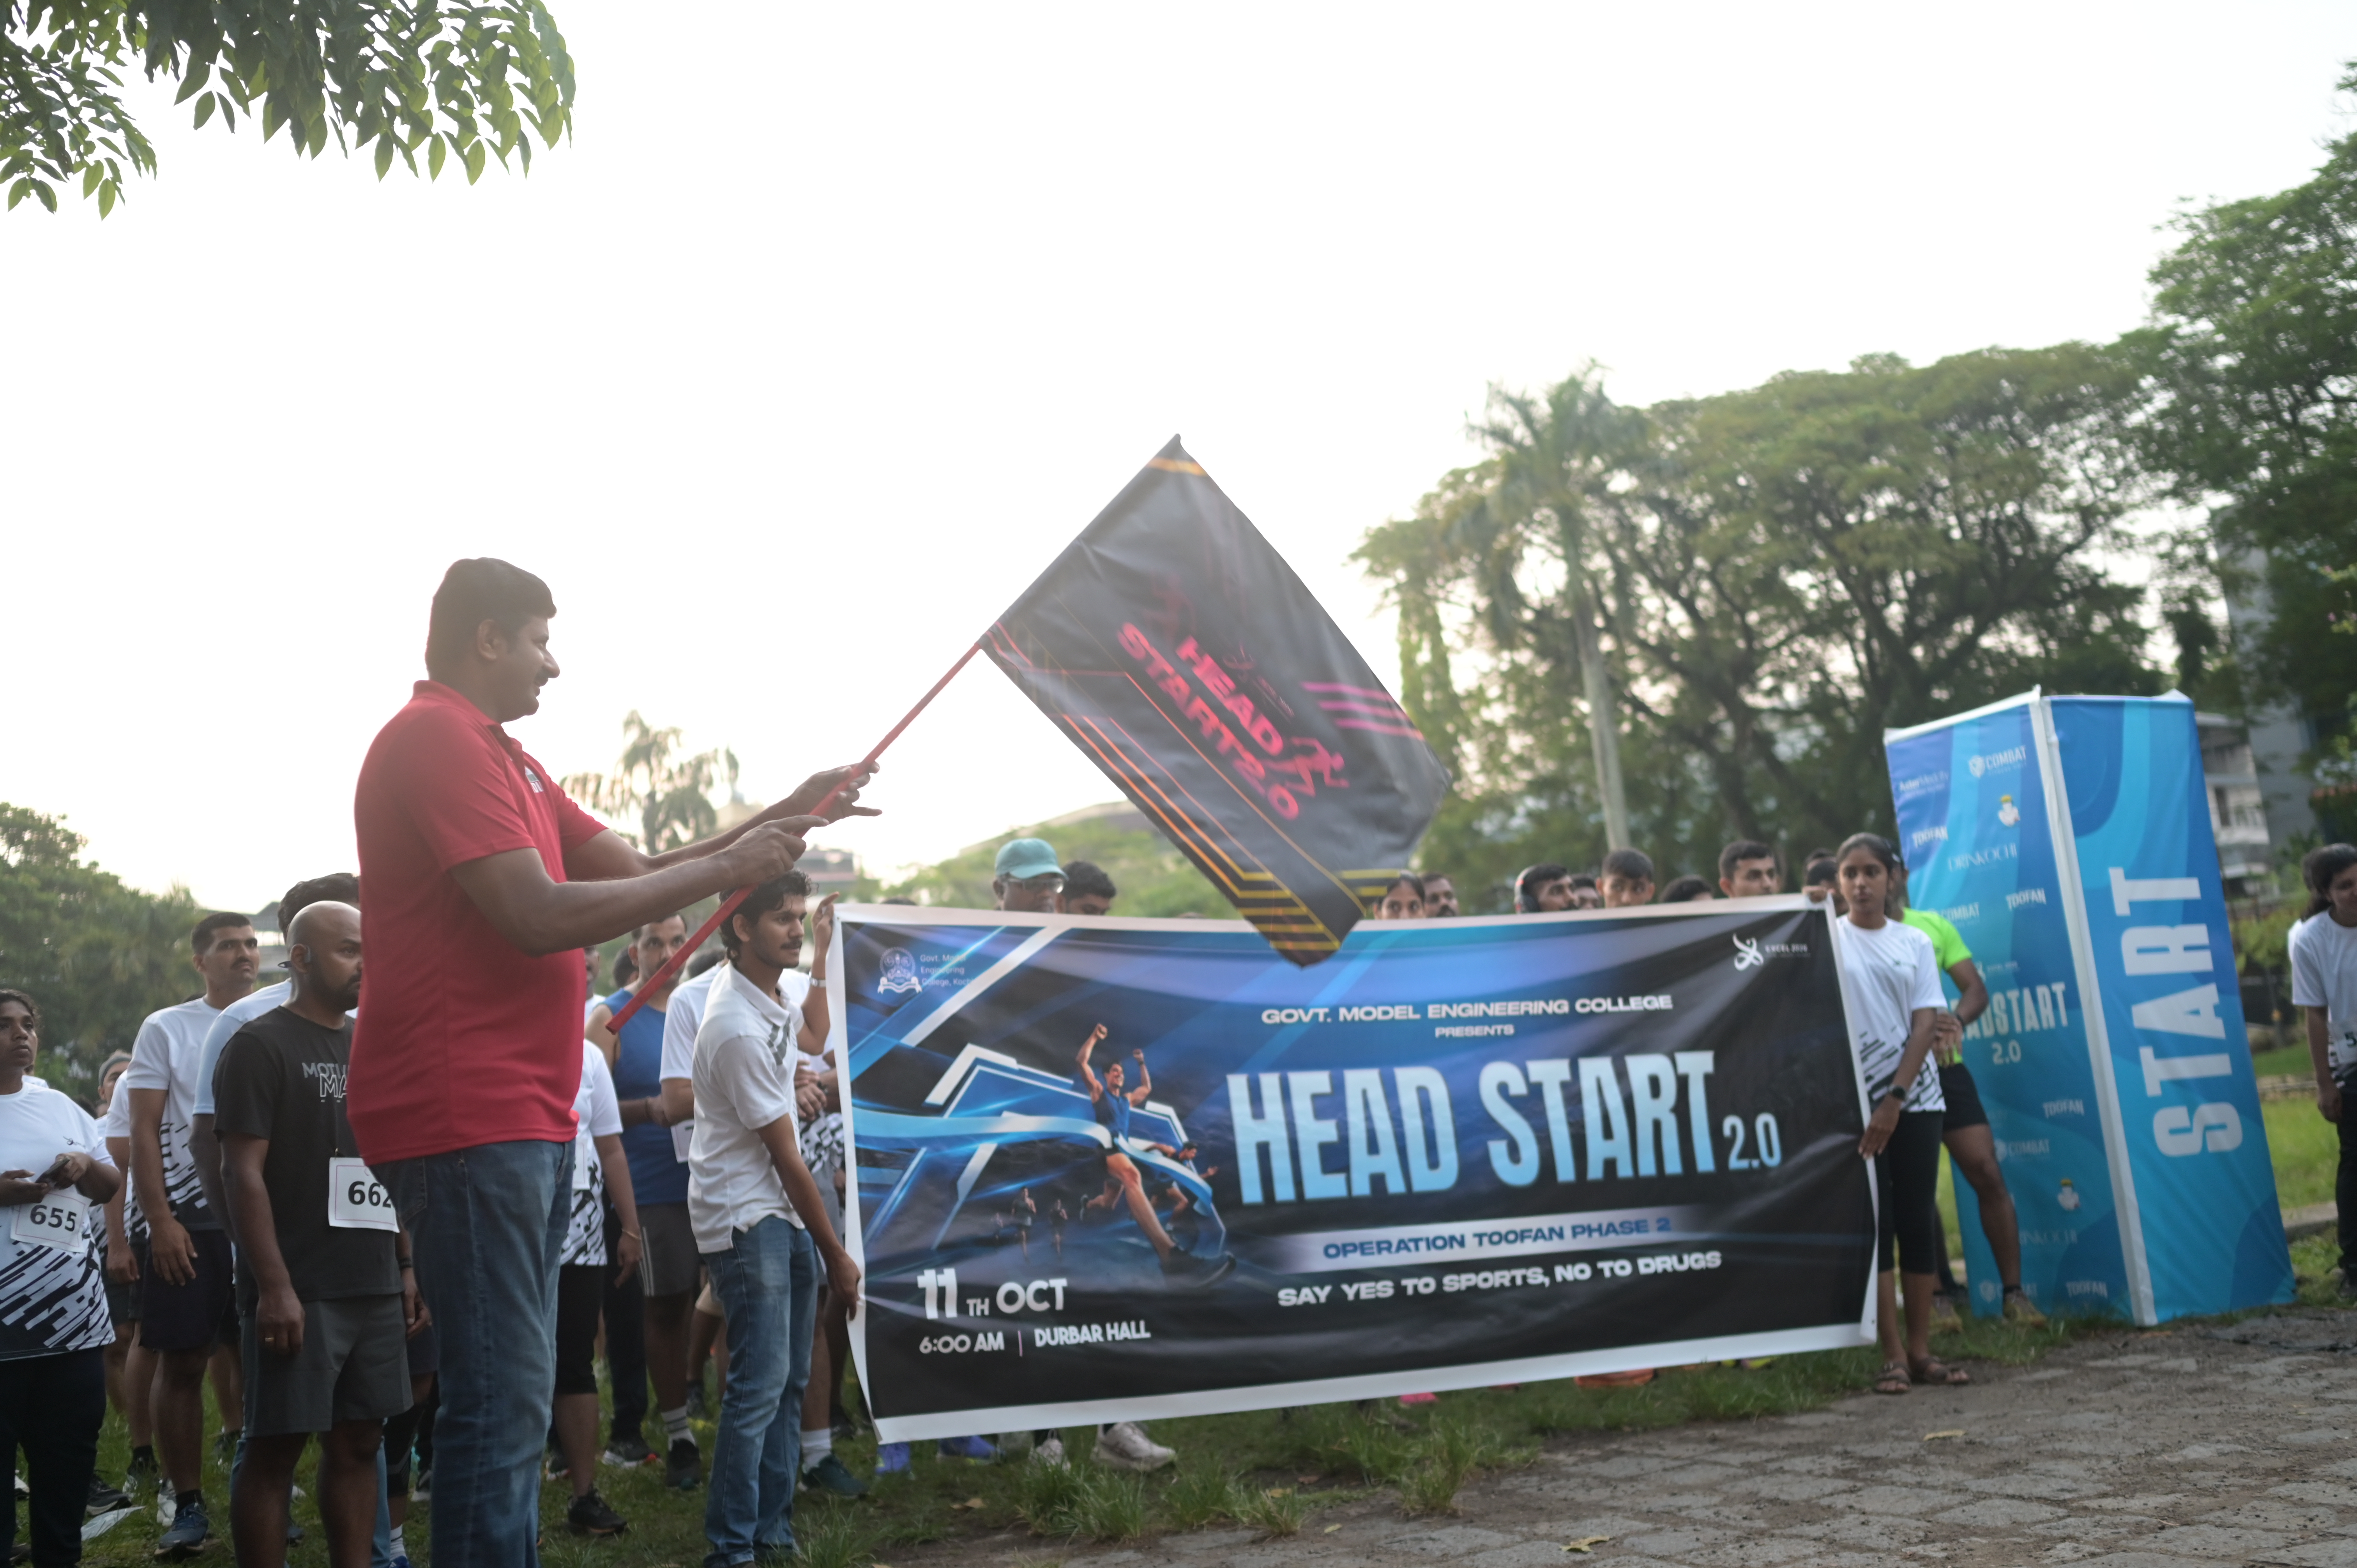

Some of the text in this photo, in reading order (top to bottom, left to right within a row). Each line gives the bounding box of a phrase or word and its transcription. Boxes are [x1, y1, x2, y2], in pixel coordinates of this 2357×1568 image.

[1117, 622, 1245, 757] START
[1176, 636, 1283, 756] HEAD
[1261, 995, 1673, 1024] GOVT. MODEL ENGINEERING COLLEGE
[1435, 1024, 1514, 1038] PRESENTS
[2109, 867, 2243, 1157] START
[1992, 1040, 2021, 1065] 2.0
[1226, 1051, 1782, 1204] HEAD START 2.0
[30, 1204, 77, 1232] 655
[1323, 1217, 1672, 1260] OPERATION TOOFAN PHASE 2
[917, 1268, 1068, 1320] 11 TH OCT
[1278, 1251, 1722, 1307] SAY YES TO SPORTS, NO TO DRUGS
[919, 1320, 1151, 1354] 6:00 AM DURBAR HALL
